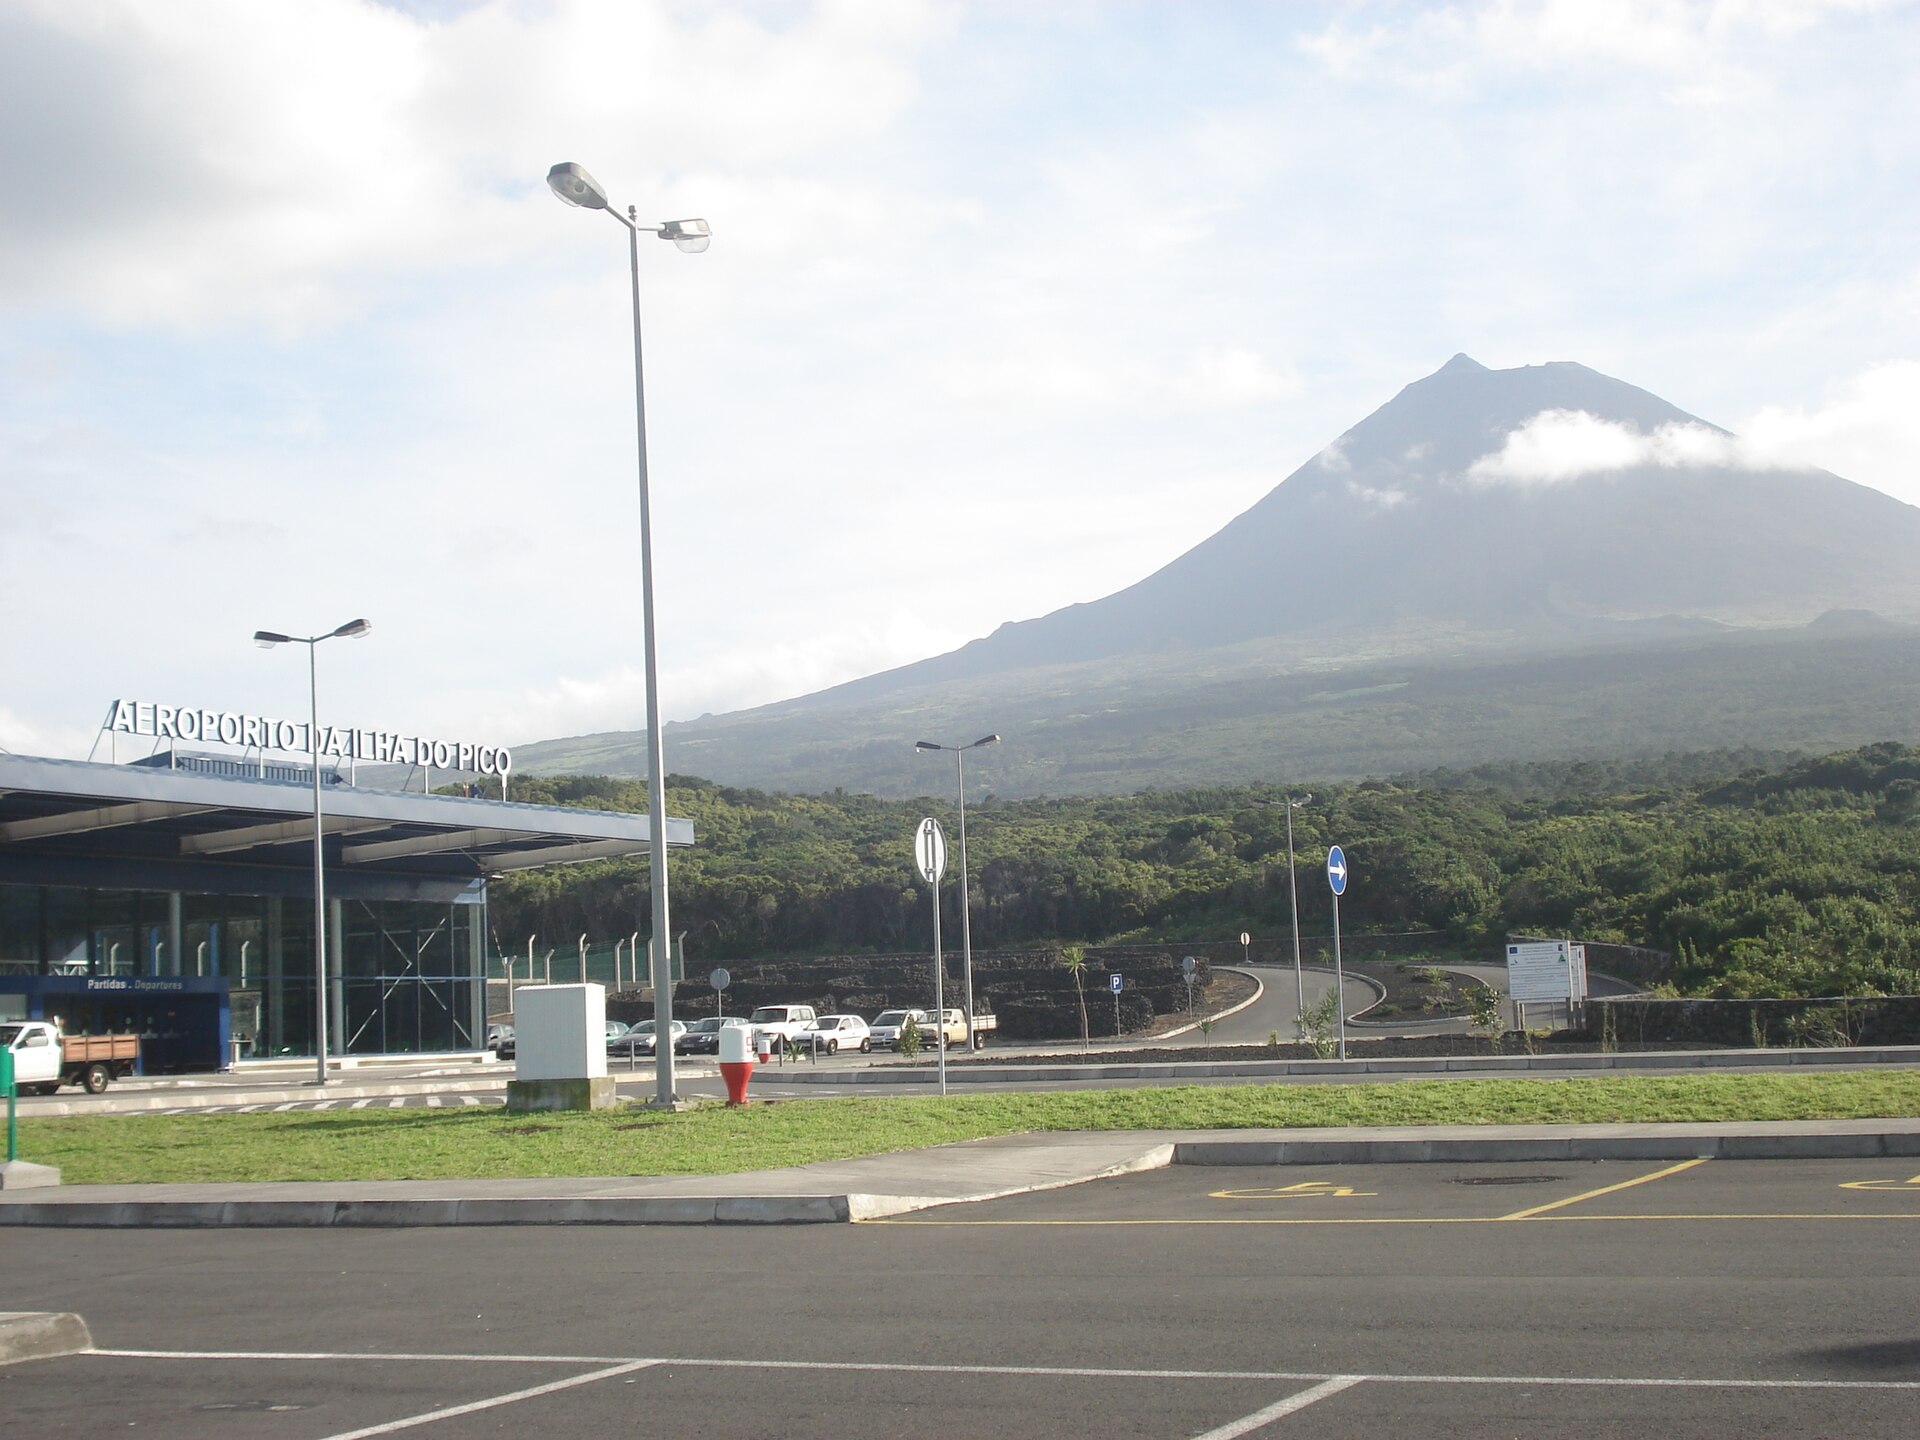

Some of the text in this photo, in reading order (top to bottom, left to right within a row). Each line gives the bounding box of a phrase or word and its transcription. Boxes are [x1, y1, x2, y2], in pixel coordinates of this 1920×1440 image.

[111, 699, 511, 775] AEROPORTO DA ILHA DO PICO
[87, 979, 126, 990] Partidas
[134, 980, 183, 991] Departures
